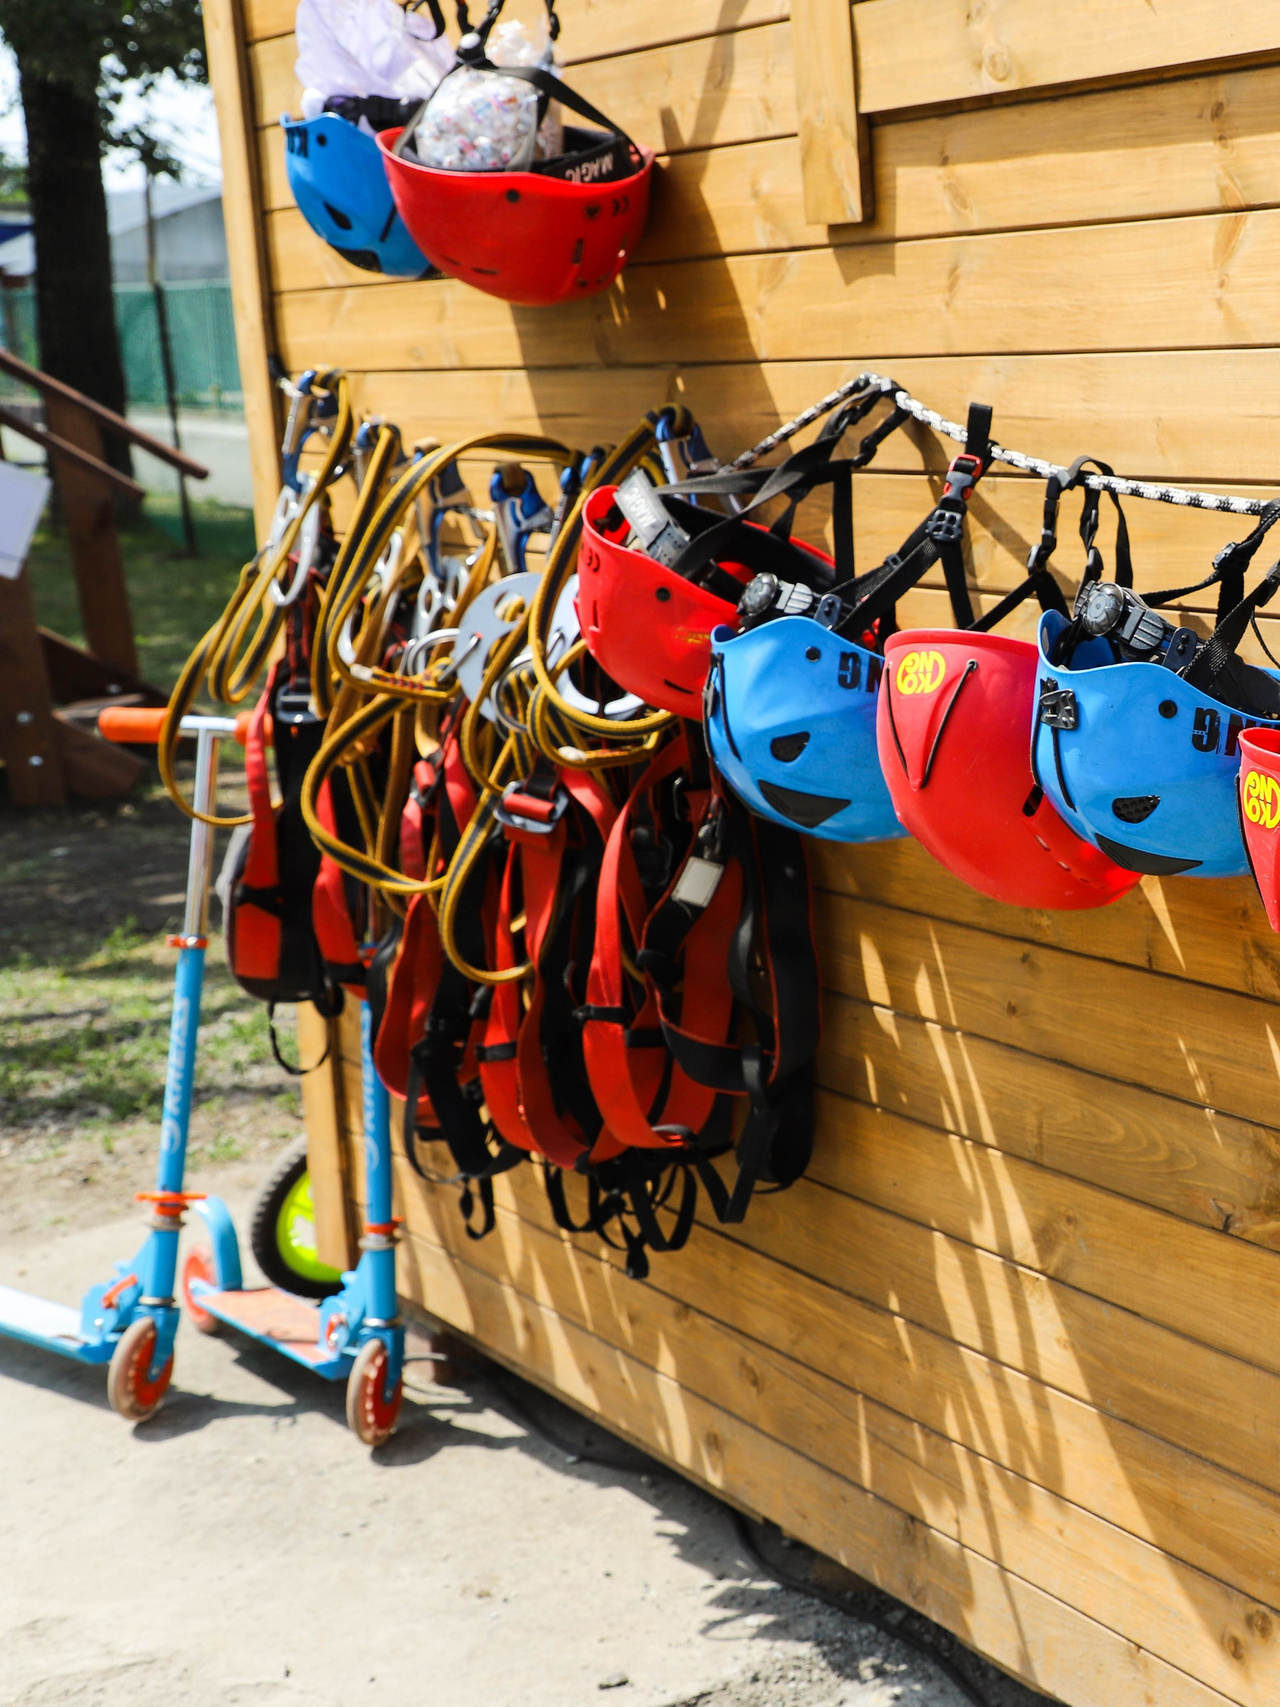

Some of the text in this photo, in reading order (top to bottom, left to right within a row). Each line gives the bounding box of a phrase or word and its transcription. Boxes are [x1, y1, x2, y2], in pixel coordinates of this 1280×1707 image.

[624, 487, 656, 529] MAGIC
[838, 651, 885, 693] NG
[896, 650, 947, 695] KONG
[1192, 707, 1257, 757] NG
